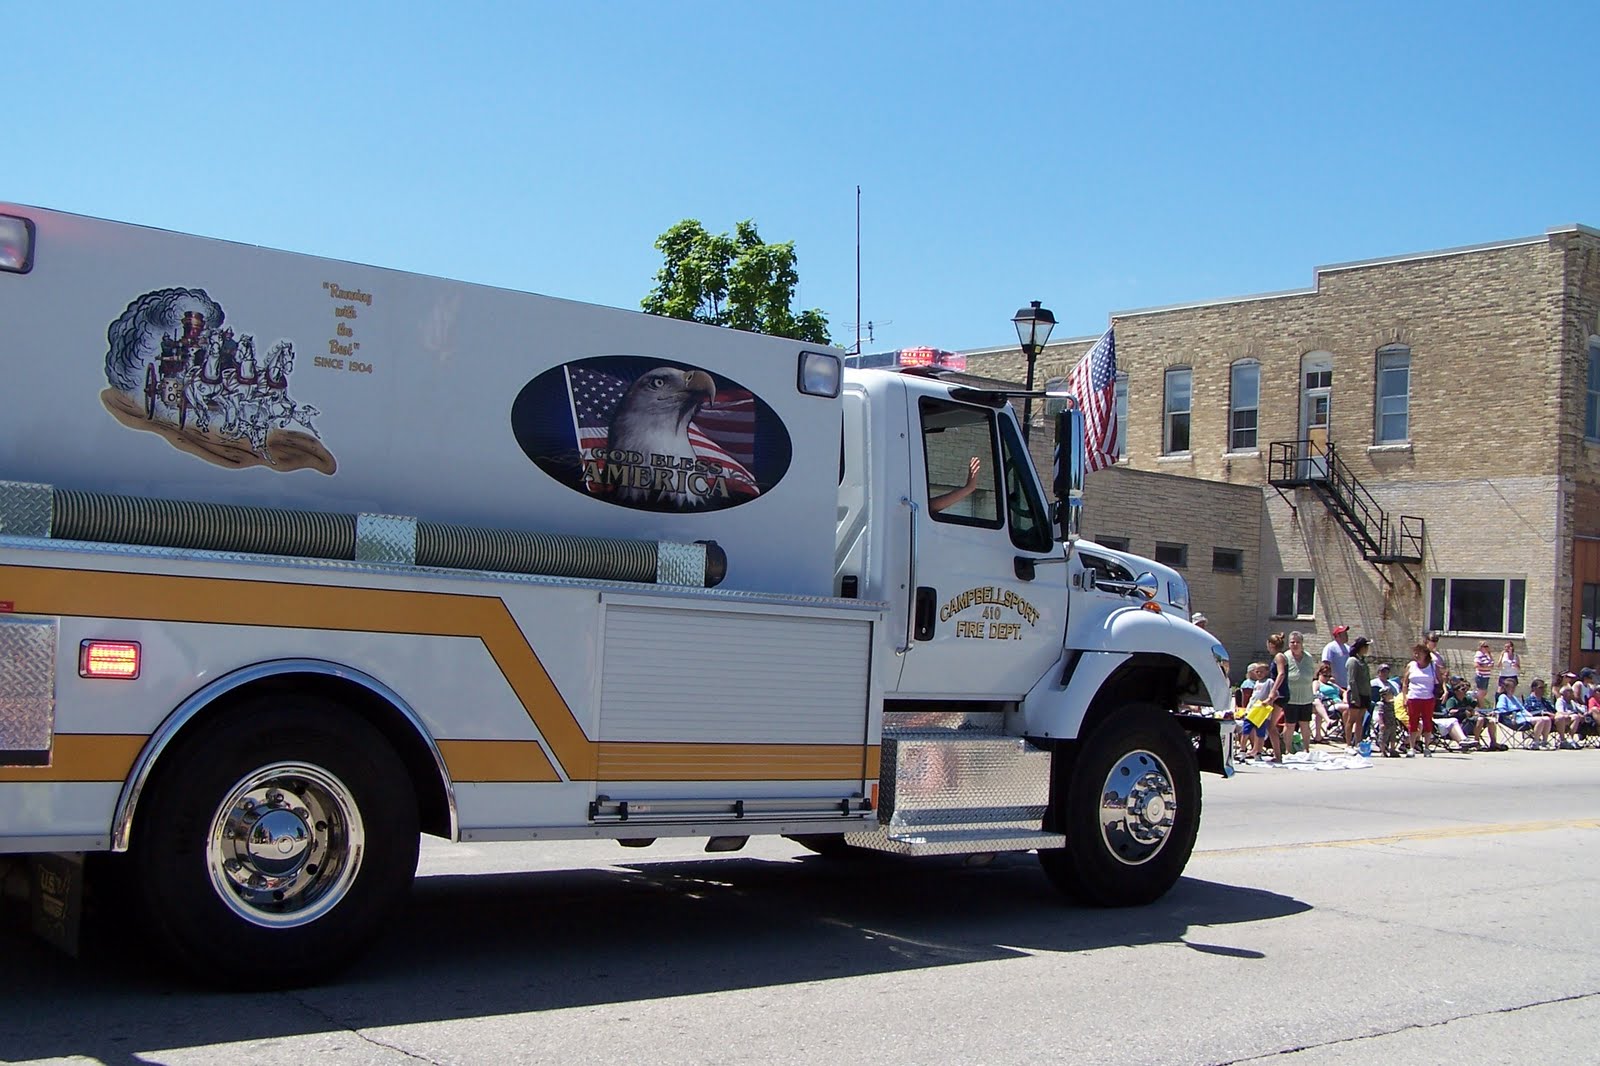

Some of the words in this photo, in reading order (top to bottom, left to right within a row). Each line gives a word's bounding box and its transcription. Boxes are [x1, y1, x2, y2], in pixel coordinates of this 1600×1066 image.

[323, 282, 372, 305] "Running
[335, 305, 357, 319] with
[337, 322, 353, 337] the
[329, 339, 360, 356] Best"
[314, 356, 343, 369] SINCE
[348, 361, 372, 374] 1904
[591, 447, 643, 464] GOD
[650, 453, 723, 475] BLESS
[579, 460, 729, 498] AMERICA
[940, 586, 1040, 627] CAMPBELLSPORT
[982, 606, 1001, 620] 410
[956, 621, 985, 639] FIRE
[989, 622, 1022, 640] DEPT.
